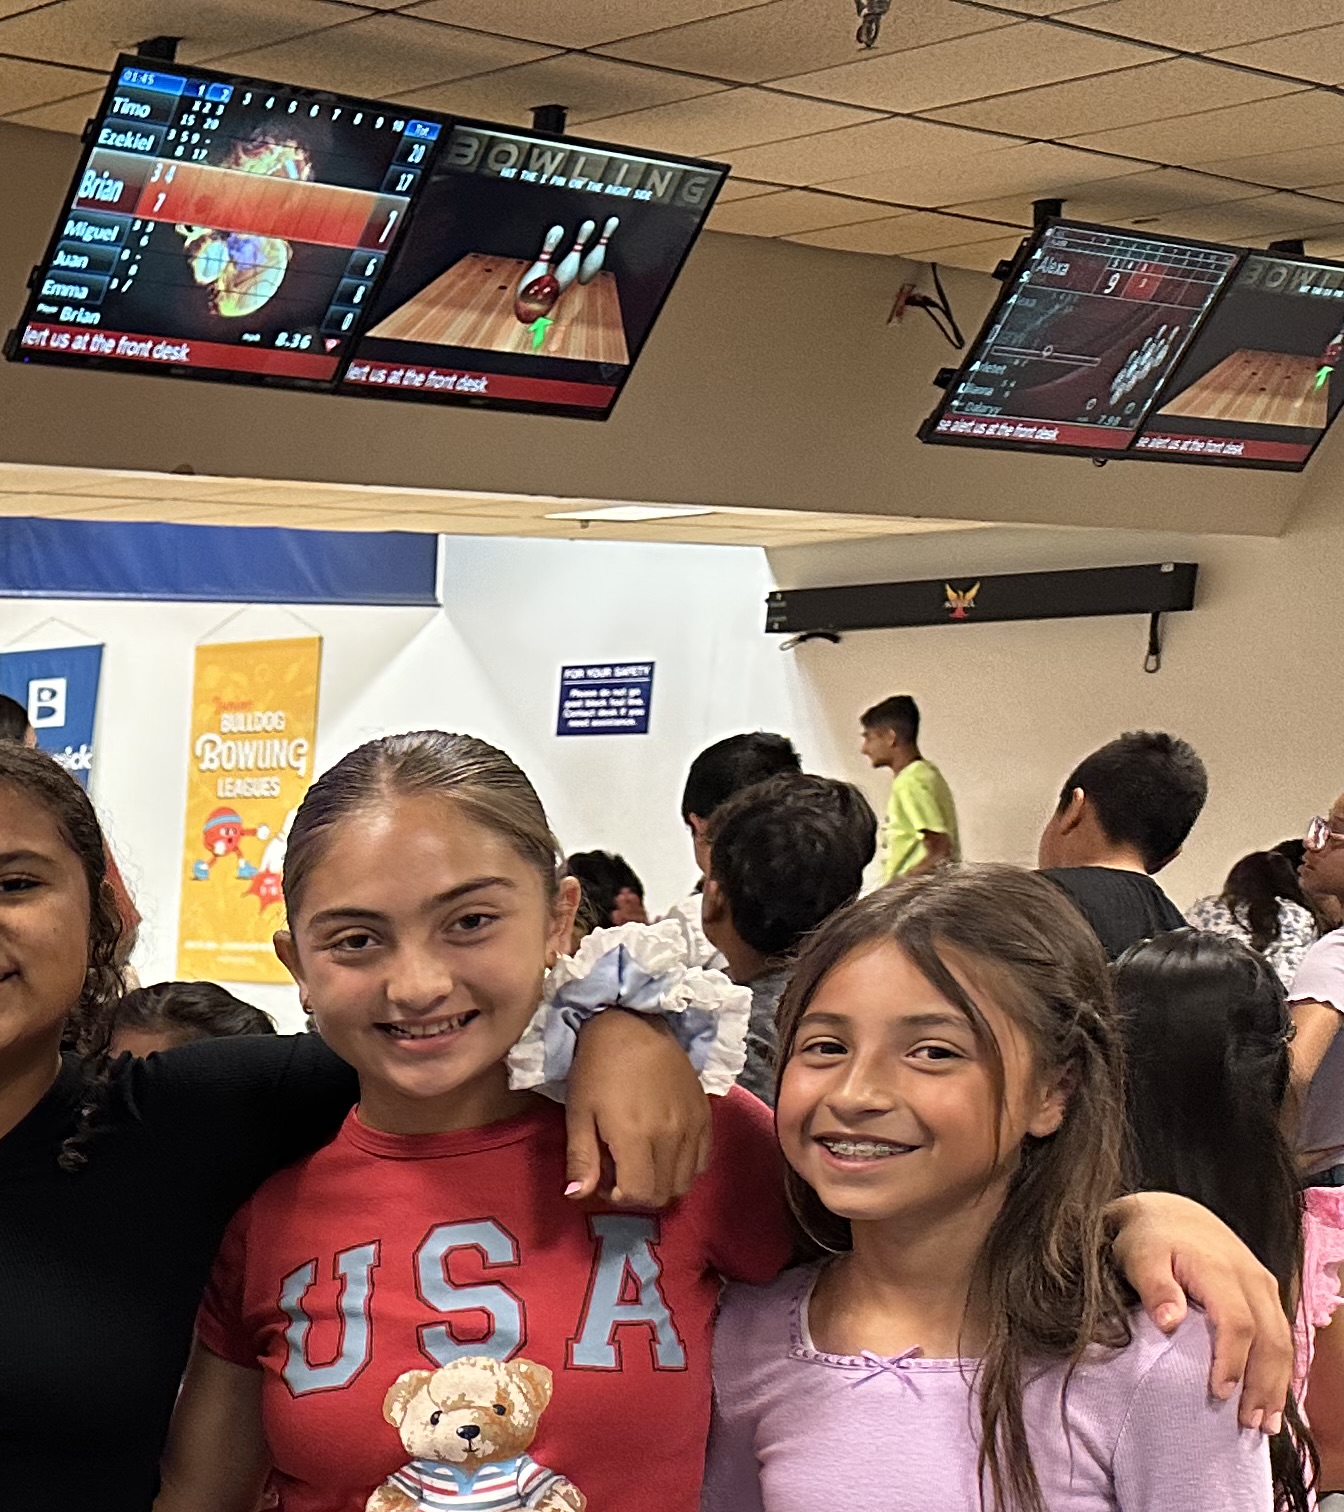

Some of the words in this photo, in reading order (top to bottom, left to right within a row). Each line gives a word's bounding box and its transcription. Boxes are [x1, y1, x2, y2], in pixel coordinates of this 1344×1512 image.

[112, 96, 151, 118] Timo
[97, 128, 155, 151] Ezekiel
[79, 169, 124, 203] Brian
[64, 219, 120, 242] Miguel
[53, 250, 89, 269] Juan
[42, 279, 89, 300] Emma
[59, 306, 101, 325] Brian
[49, 332, 70, 349] us
[71, 333, 89, 350] at
[89, 333, 116, 354] the
[117, 336, 153, 358] front
[563, 668, 585, 679] FOR
[586, 667, 612, 678] YOUR
[613, 665, 652, 677] SAFETY
[220, 711, 285, 733] BULLDOG
[195, 733, 308, 777] BOWLING
[217, 777, 280, 798] LEAGUES
[278, 1211, 688, 1399] USA
